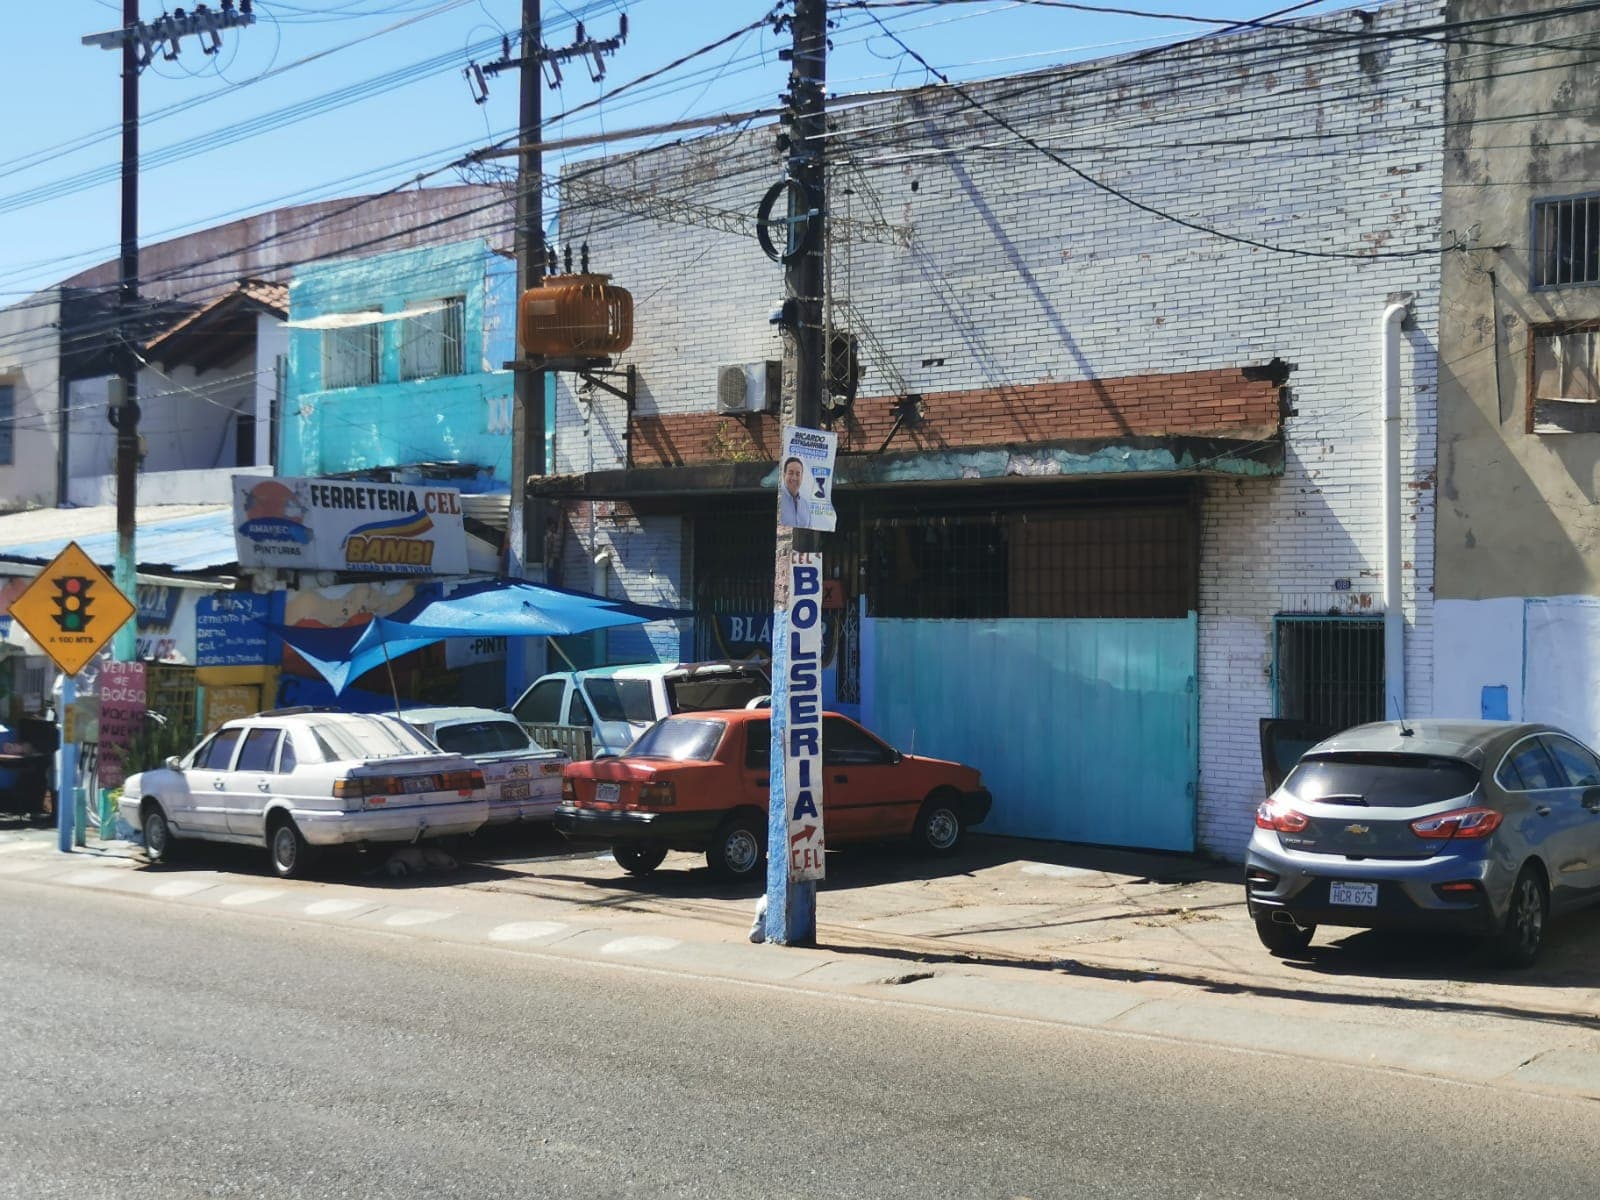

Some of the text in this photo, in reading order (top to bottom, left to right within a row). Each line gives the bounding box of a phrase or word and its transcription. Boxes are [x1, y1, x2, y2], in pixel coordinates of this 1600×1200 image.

[795, 432, 826, 443] RICARDO
[814, 477, 826, 498] 3
[310, 484, 461, 515] FERRETERIA CEL
[254, 544, 302, 556] PINTURAS
[346, 536, 434, 565] BAMBI
[212, 599, 253, 611] HAY
[790, 566, 820, 821] BOLSERIA
[791, 848, 823, 870] CEL
[1333, 889, 1373, 904] HCR 675
